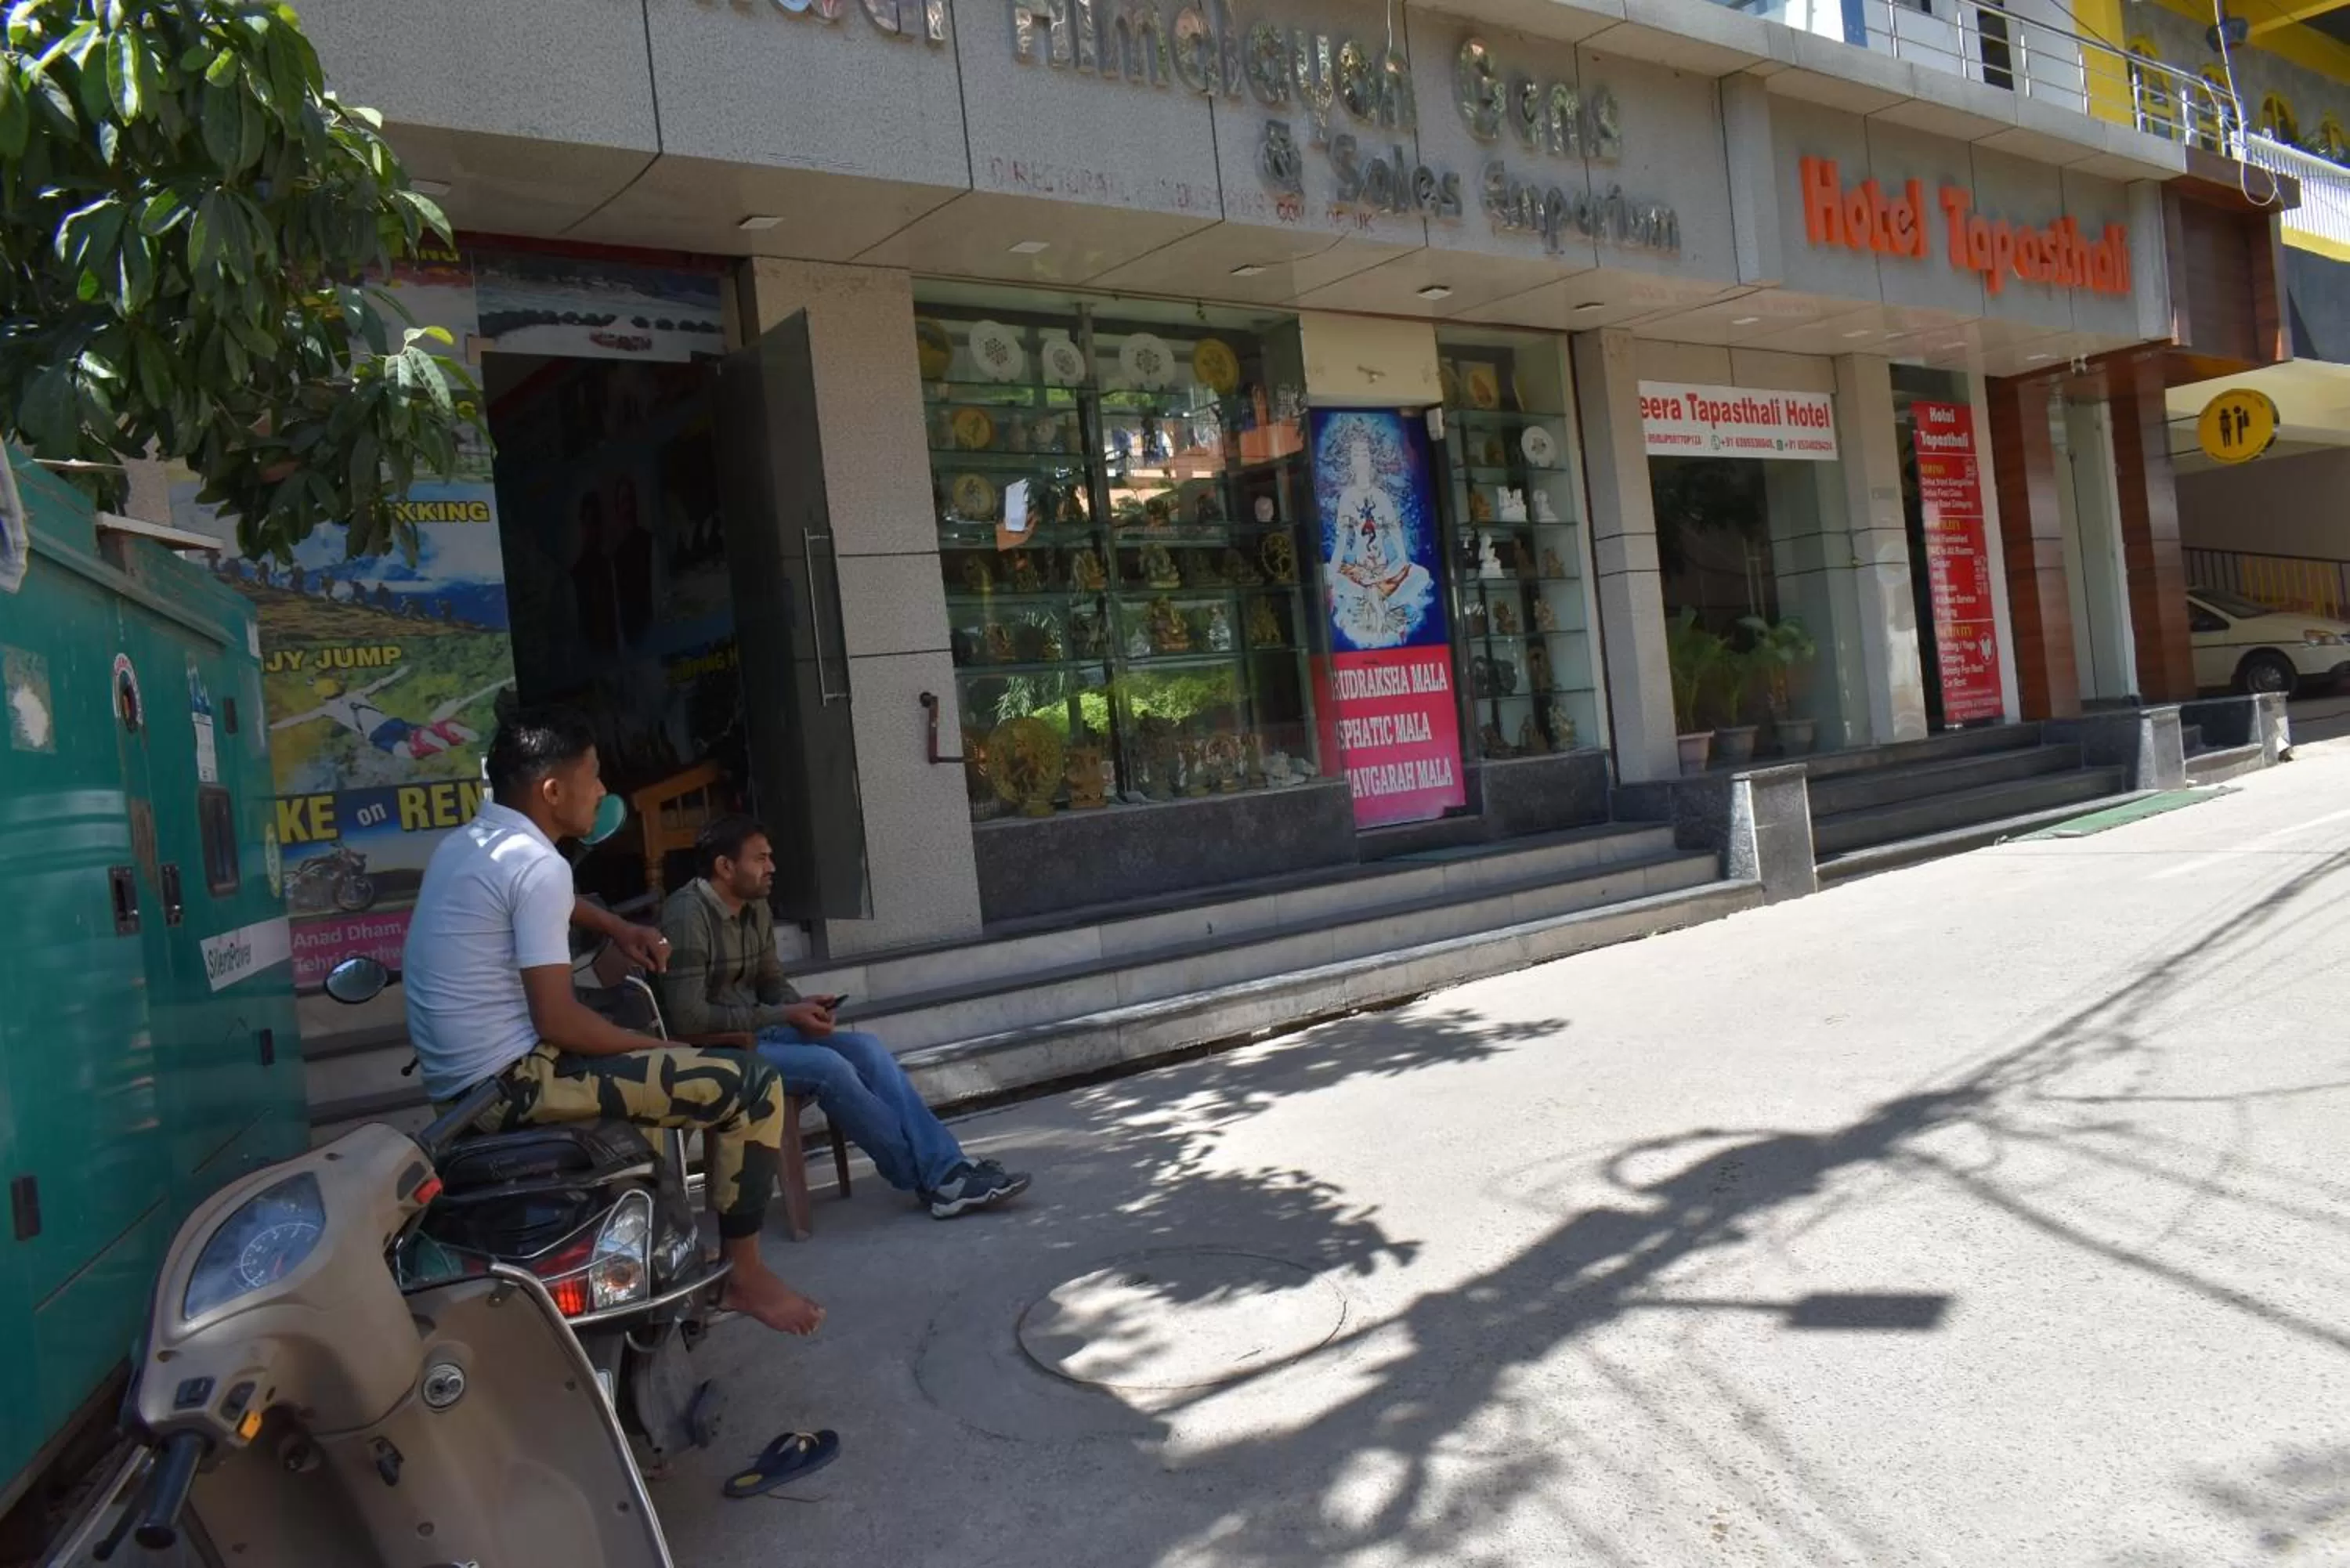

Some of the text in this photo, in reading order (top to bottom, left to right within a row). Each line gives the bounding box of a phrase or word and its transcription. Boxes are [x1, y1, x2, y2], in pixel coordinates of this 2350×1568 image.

[1800, 156, 2131, 294] Hotel Tapasthali
[1686, 392, 1781, 429] Tapasthali
[1785, 399, 1831, 428] Hotel
[1929, 406, 1956, 424] Hotel
[1920, 431, 1969, 451] Tapasthali
[262, 645, 402, 672] JY JUMP
[1411, 662, 1448, 693] MALA
[1394, 711, 1433, 743] MALA
[1416, 757, 1454, 789] MALA
[356, 802, 387, 826] on
[294, 927, 343, 948] Anad
